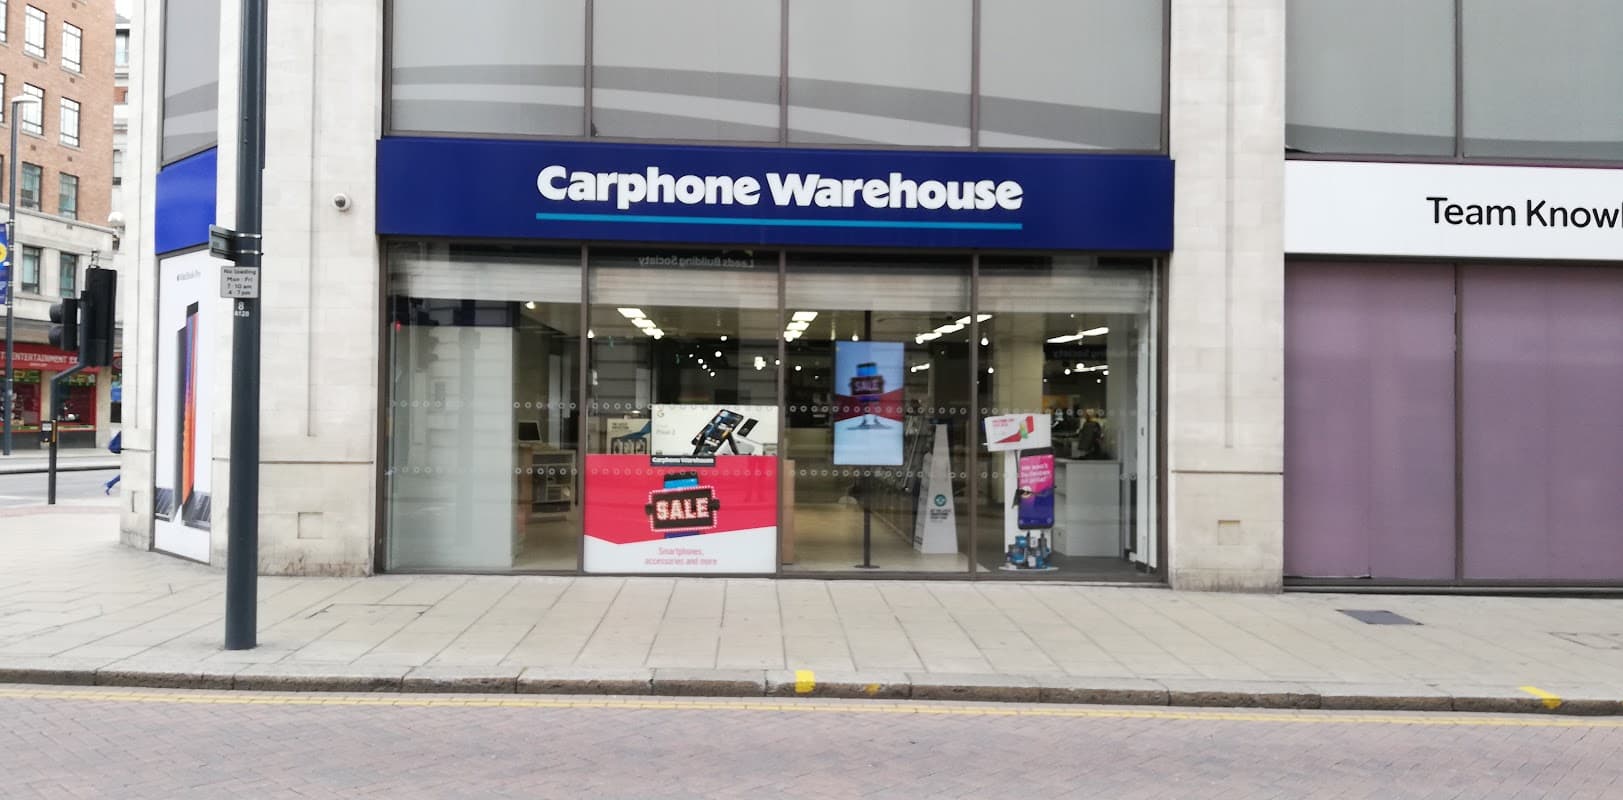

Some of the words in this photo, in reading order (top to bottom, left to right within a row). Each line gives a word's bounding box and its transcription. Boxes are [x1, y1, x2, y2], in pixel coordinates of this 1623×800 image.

[536, 165, 761, 210] Carphone
[766, 172, 1024, 210] Warehouse
[1426, 197, 1517, 227] Team
[855, 379, 880, 392] SALE
[656, 497, 710, 521] SALE
